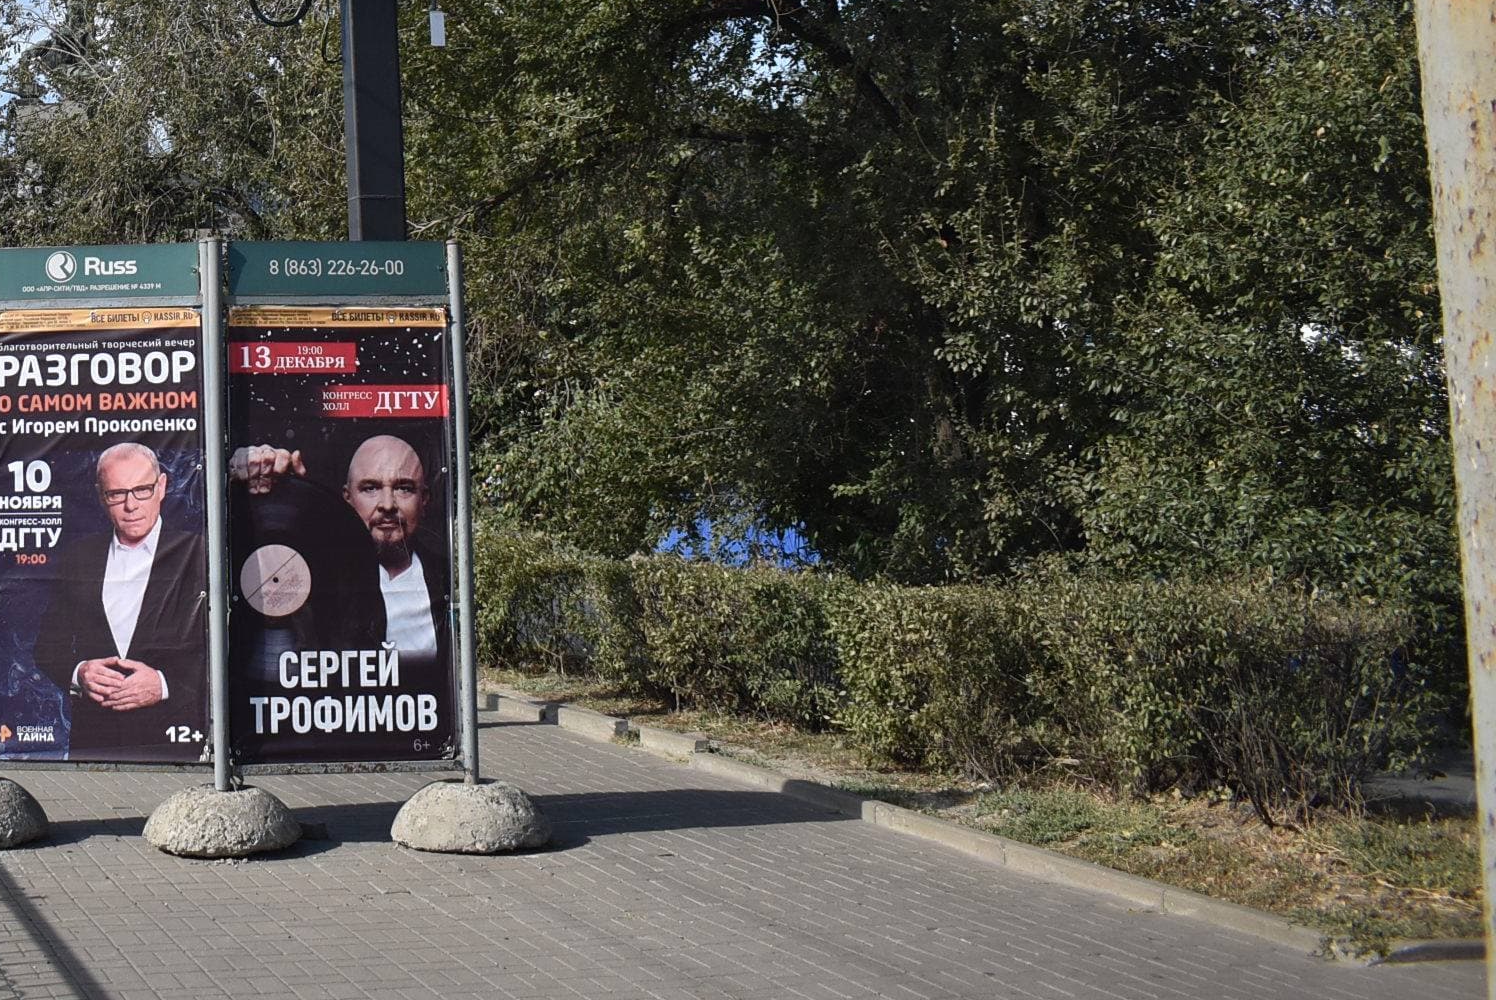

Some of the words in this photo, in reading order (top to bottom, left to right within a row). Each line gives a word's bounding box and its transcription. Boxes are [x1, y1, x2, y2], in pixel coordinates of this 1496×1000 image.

[84, 256, 138, 275] Russ
[269, 260, 279, 275] 8
[284, 259, 322, 277] (863)
[328, 259, 404, 275] 226-26-00
[107, 313, 140, 323] БИЛЕТЫ
[350, 312, 384, 321] БИЛЕТЫ
[101, 338, 161, 350] творческий
[164, 339, 195, 349] вечер
[297, 346, 323, 355] 19:00
[240, 345, 272, 369] 13
[273, 356, 345, 371] ДЕКАБРЯ
[18, 393, 92, 412] САМОМ
[98, 391, 197, 410] ВАЖНОМ
[322, 391, 373, 400] КОНГРЕСС
[374, 391, 440, 414] ДГТУ
[322, 402, 350, 411] ХОЛЛ
[12, 419, 79, 437] Игорем
[85, 417, 197, 436] Прокопенко
[8, 460, 51, 492] 10
[0, 518, 62, 526] КОНГРЕСС-ХОЛЛ
[0, 527, 62, 552] ДГТУ
[16, 554, 46, 564] 19:00
[279, 641, 399, 688] СЕРГЕЙ
[250, 694, 438, 734] ТРОФИМОВ
[17, 725, 54, 733] ВОЕННАЯ
[17, 731, 54, 742] ТАЙНА
[166, 726, 203, 742] 12+
[413, 738, 431, 751] 6+
